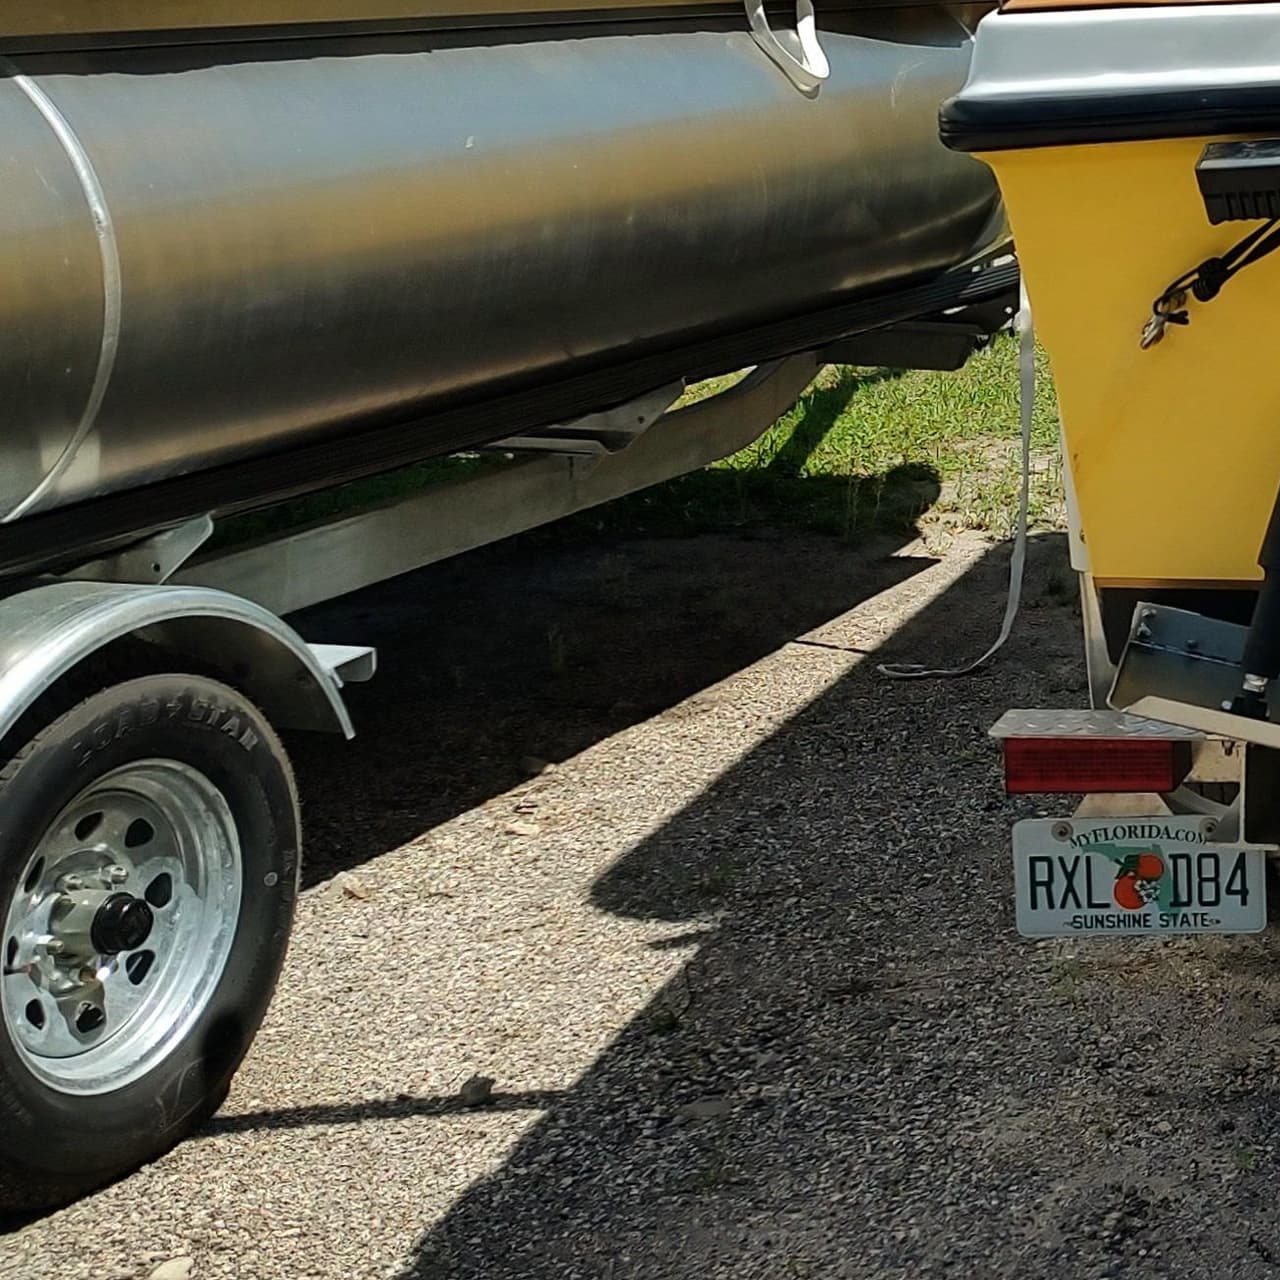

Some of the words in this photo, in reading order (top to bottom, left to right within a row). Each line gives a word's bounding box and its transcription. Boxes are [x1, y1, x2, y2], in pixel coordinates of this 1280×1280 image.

[1069, 824, 1207, 849] MYFLORIDA.COM
[1029, 855, 1110, 910] RXL
[1168, 852, 1249, 908] D84
[1072, 914, 1152, 929] SUNSHINE
[1159, 913, 1210, 928] STATE
